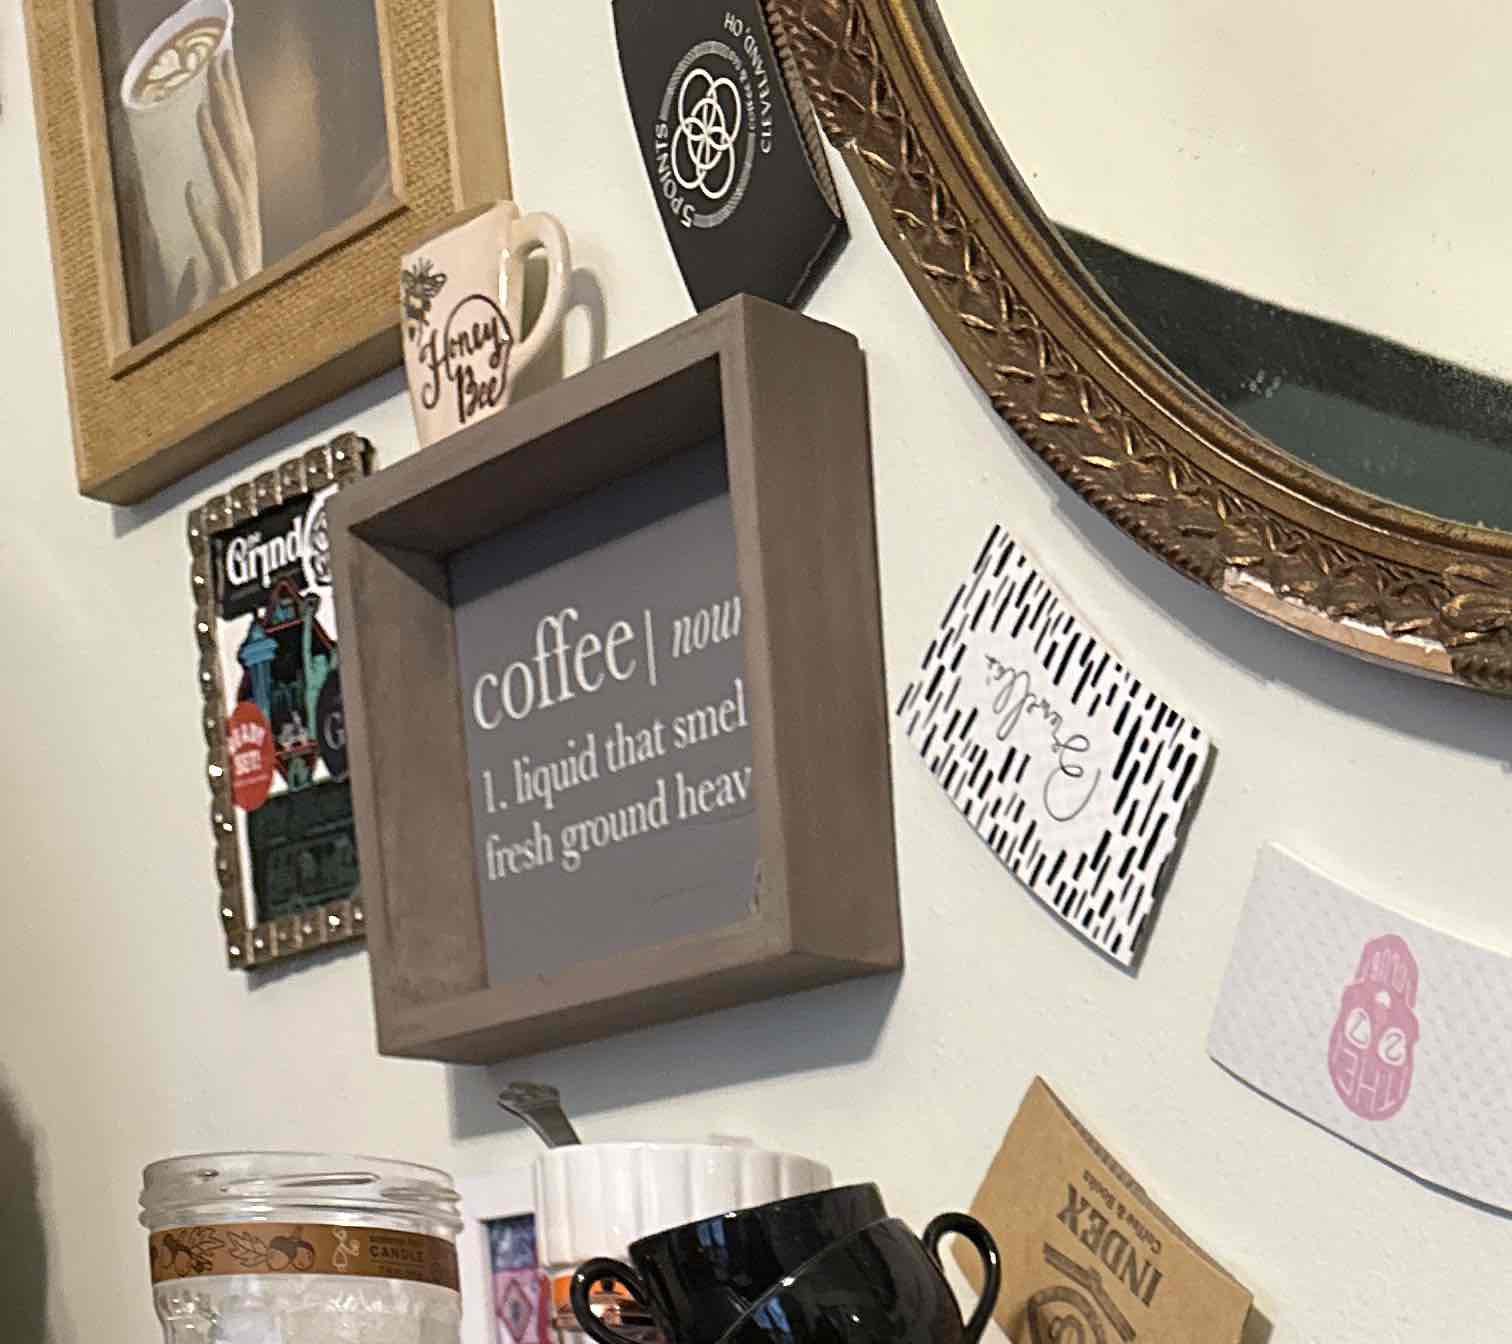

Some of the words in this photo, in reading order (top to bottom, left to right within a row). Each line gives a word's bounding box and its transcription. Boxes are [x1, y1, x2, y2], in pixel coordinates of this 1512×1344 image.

[723, 12, 743, 37] OH
[655, 122, 685, 216] POINTS
[680, 203, 696, 229] 5
[418, 315, 503, 409] Honey
[455, 364, 500, 424] Bee
[226, 516, 304, 588] Grind
[472, 607, 637, 730] coffee
[483, 769, 508, 814] 1.
[513, 733, 599, 810] liquid
[605, 721, 664, 773] that
[486, 820, 555, 881] fresh
[560, 778, 669, 872] ground
[1056, 1182, 1164, 1308] INDEX
